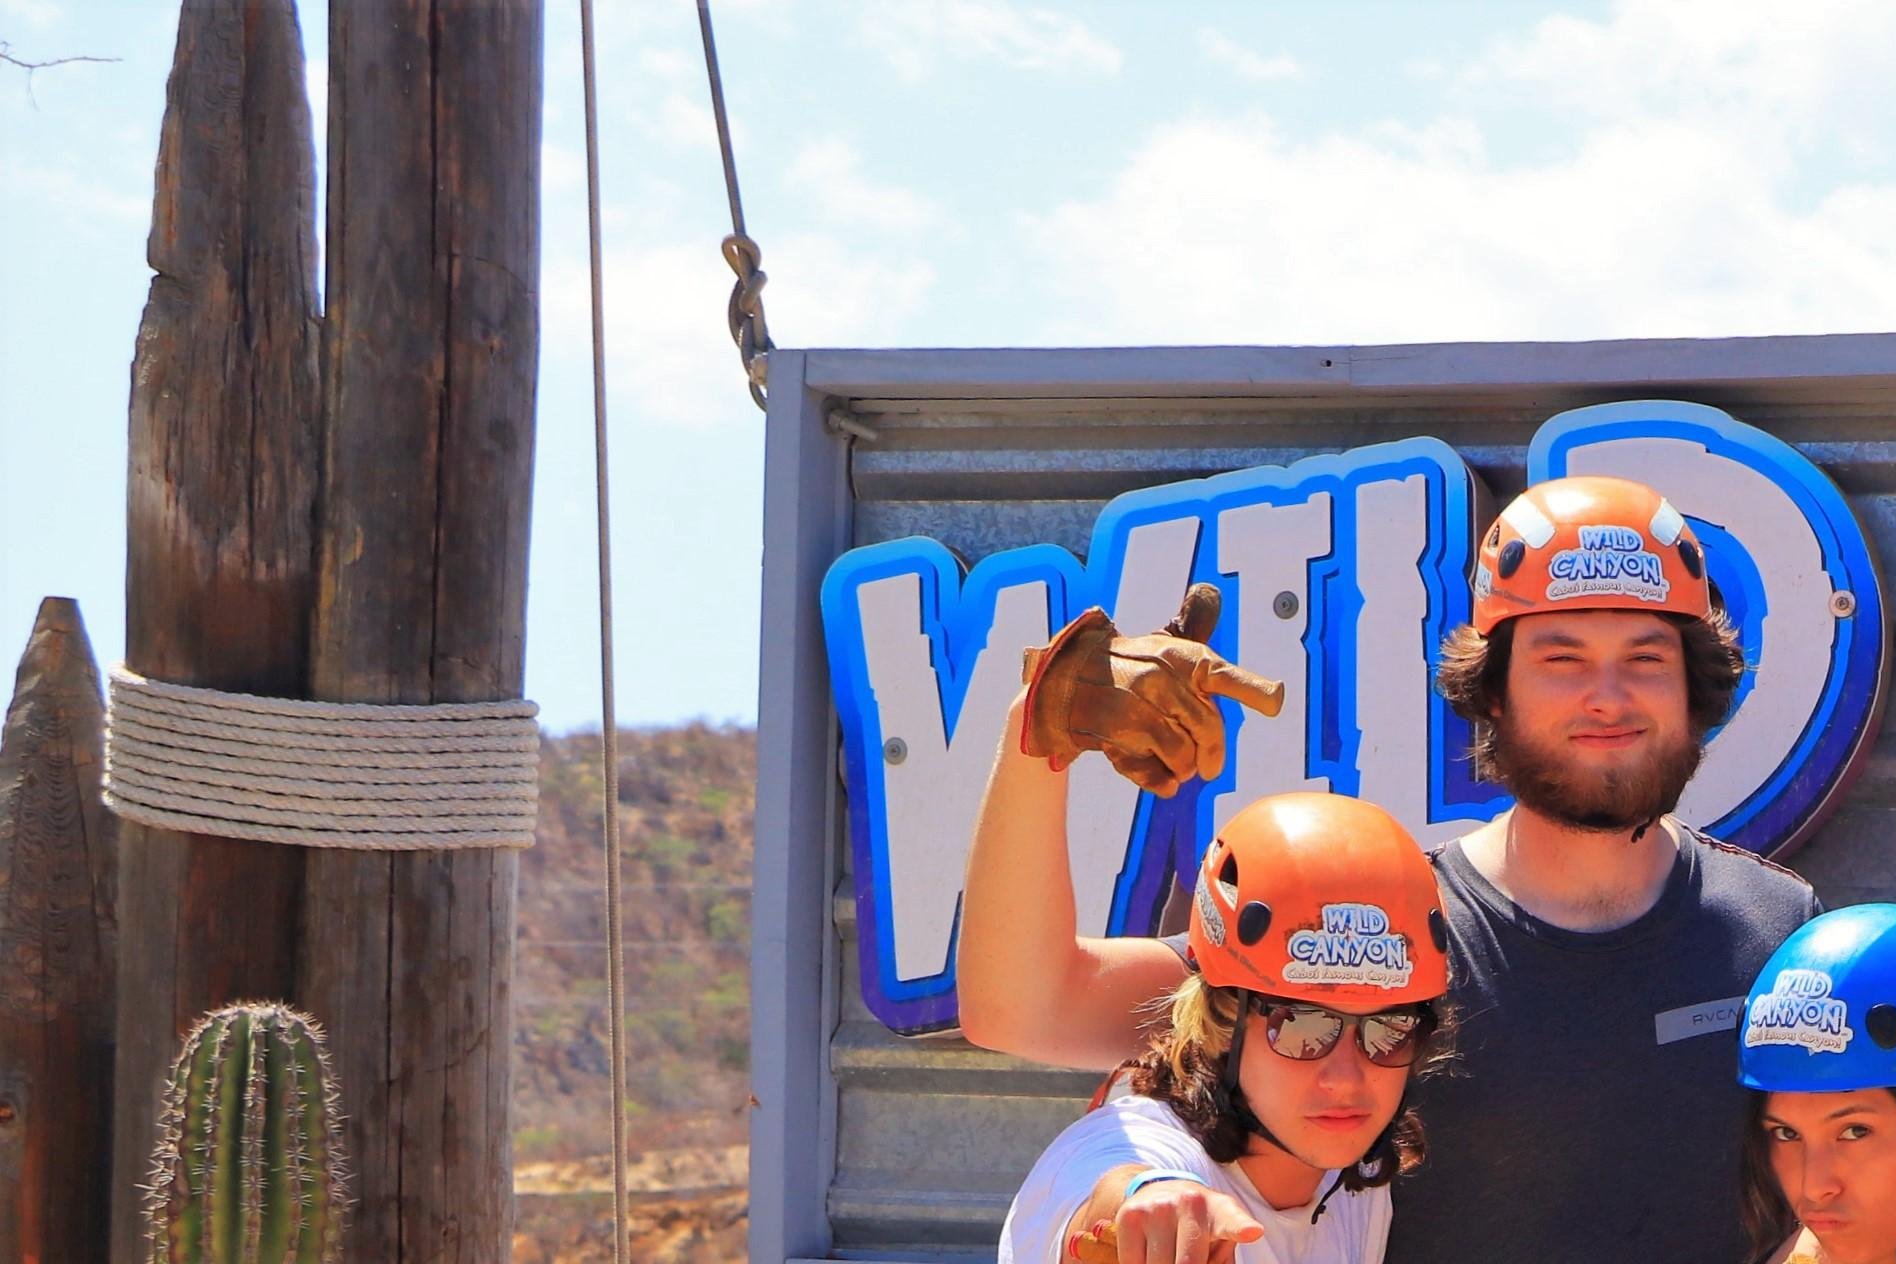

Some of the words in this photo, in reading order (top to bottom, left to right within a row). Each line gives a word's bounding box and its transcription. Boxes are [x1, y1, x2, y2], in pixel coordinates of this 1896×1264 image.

[1580, 528, 1641, 551] WILD
[1550, 551, 1661, 586] CANYON
[1325, 906, 1386, 935] WILD
[1290, 934, 1407, 969] CANYON
[1777, 973, 1830, 999] WILD
[1749, 997, 1843, 1036] CANYON
